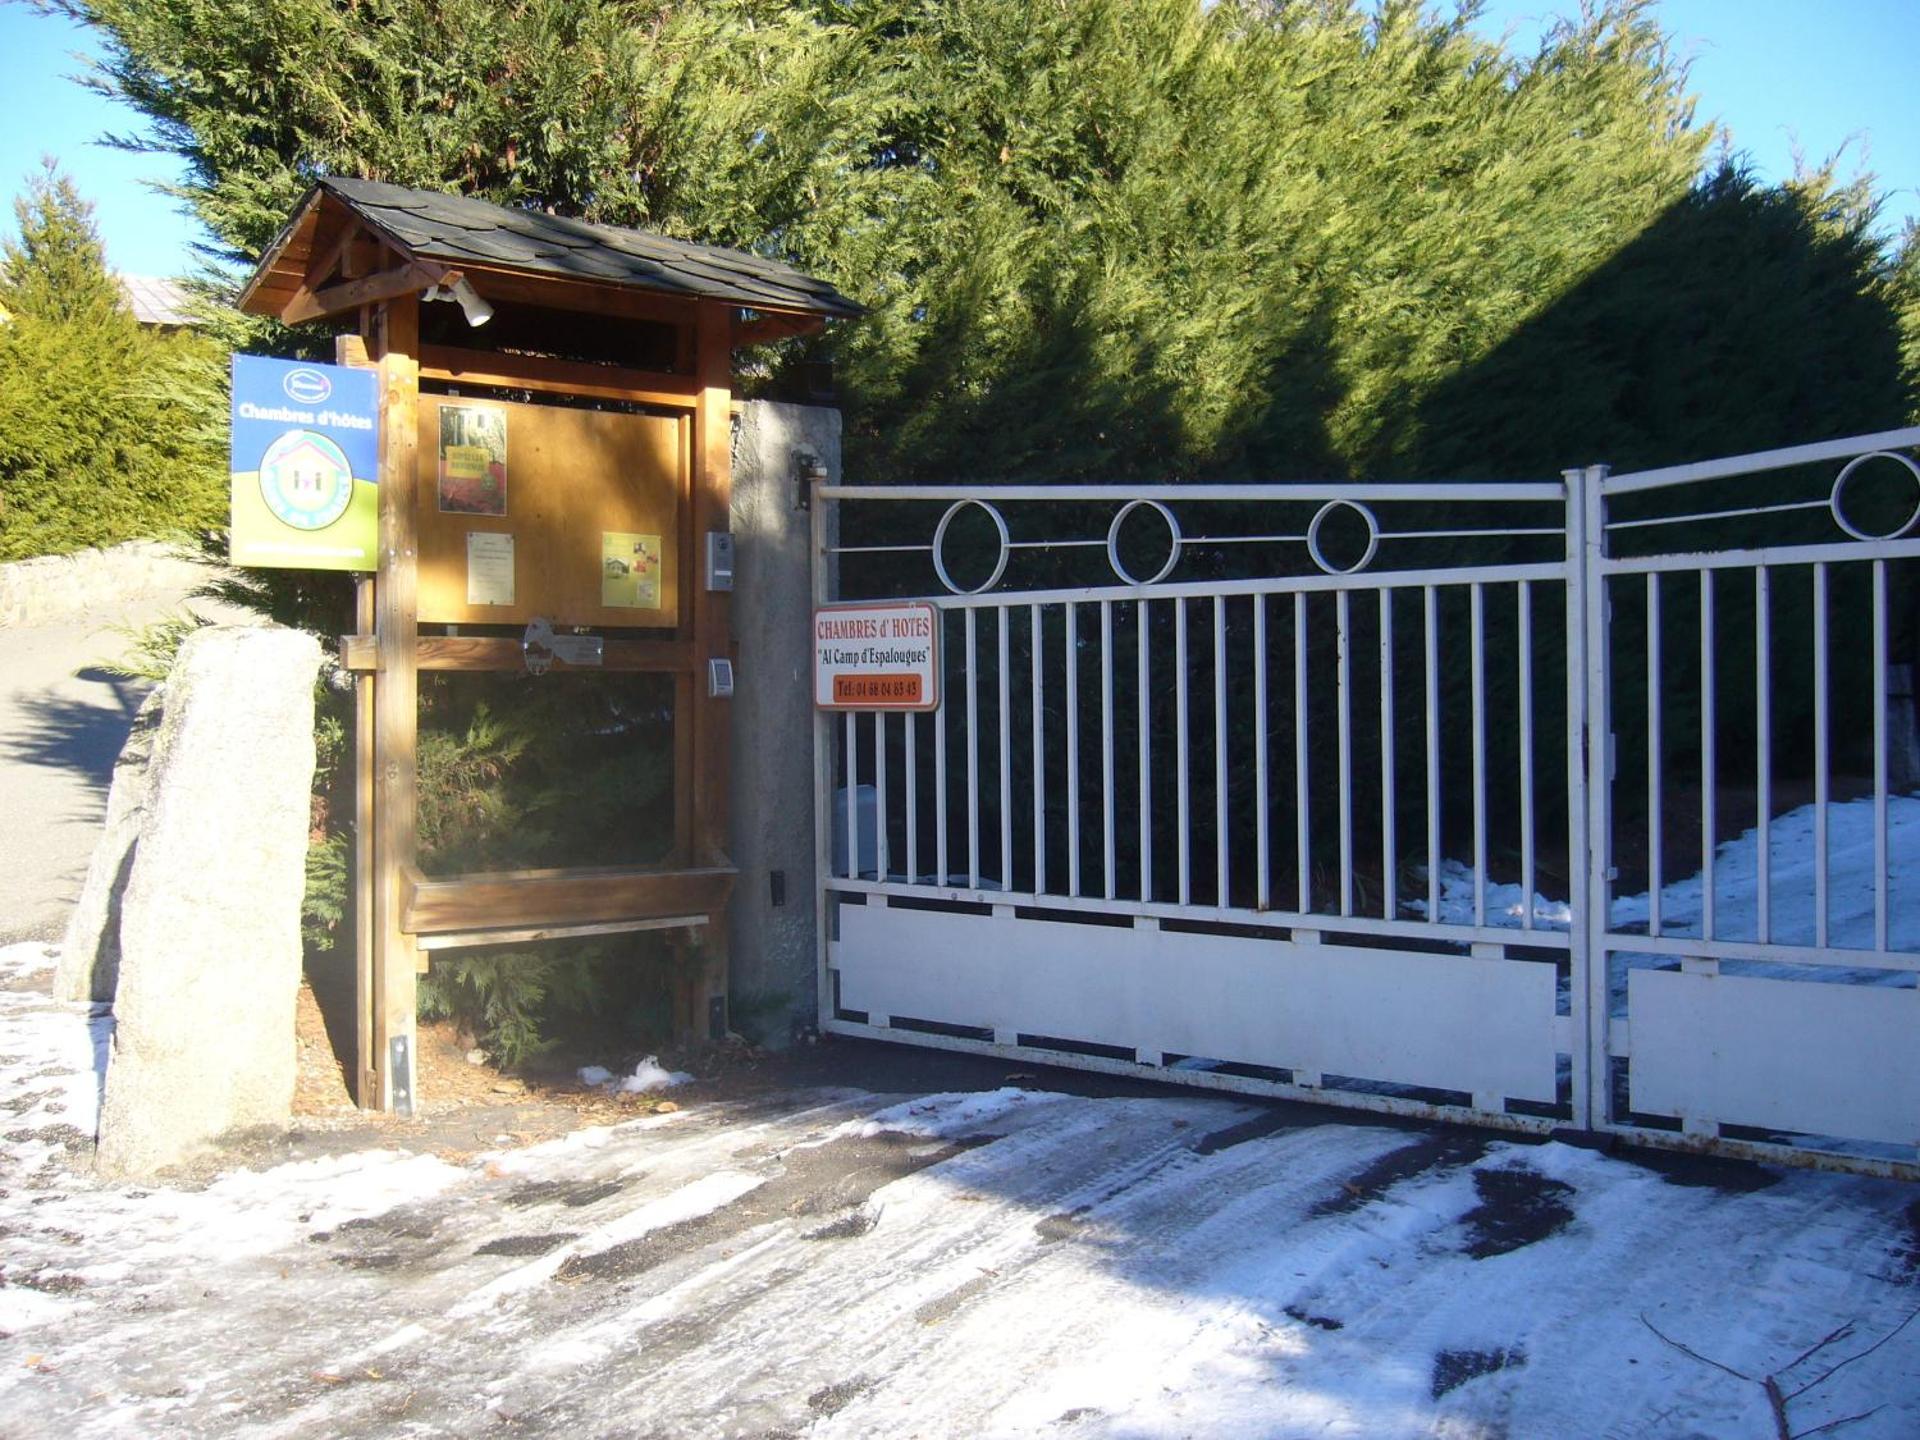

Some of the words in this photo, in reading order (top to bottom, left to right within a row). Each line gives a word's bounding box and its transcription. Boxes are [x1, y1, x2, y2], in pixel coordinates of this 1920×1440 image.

[239, 402, 314, 425] Chambres
[317, 409, 373, 430] d'hôtes
[818, 619, 877, 640] CHAMBRES
[834, 648, 859, 666] Camp
